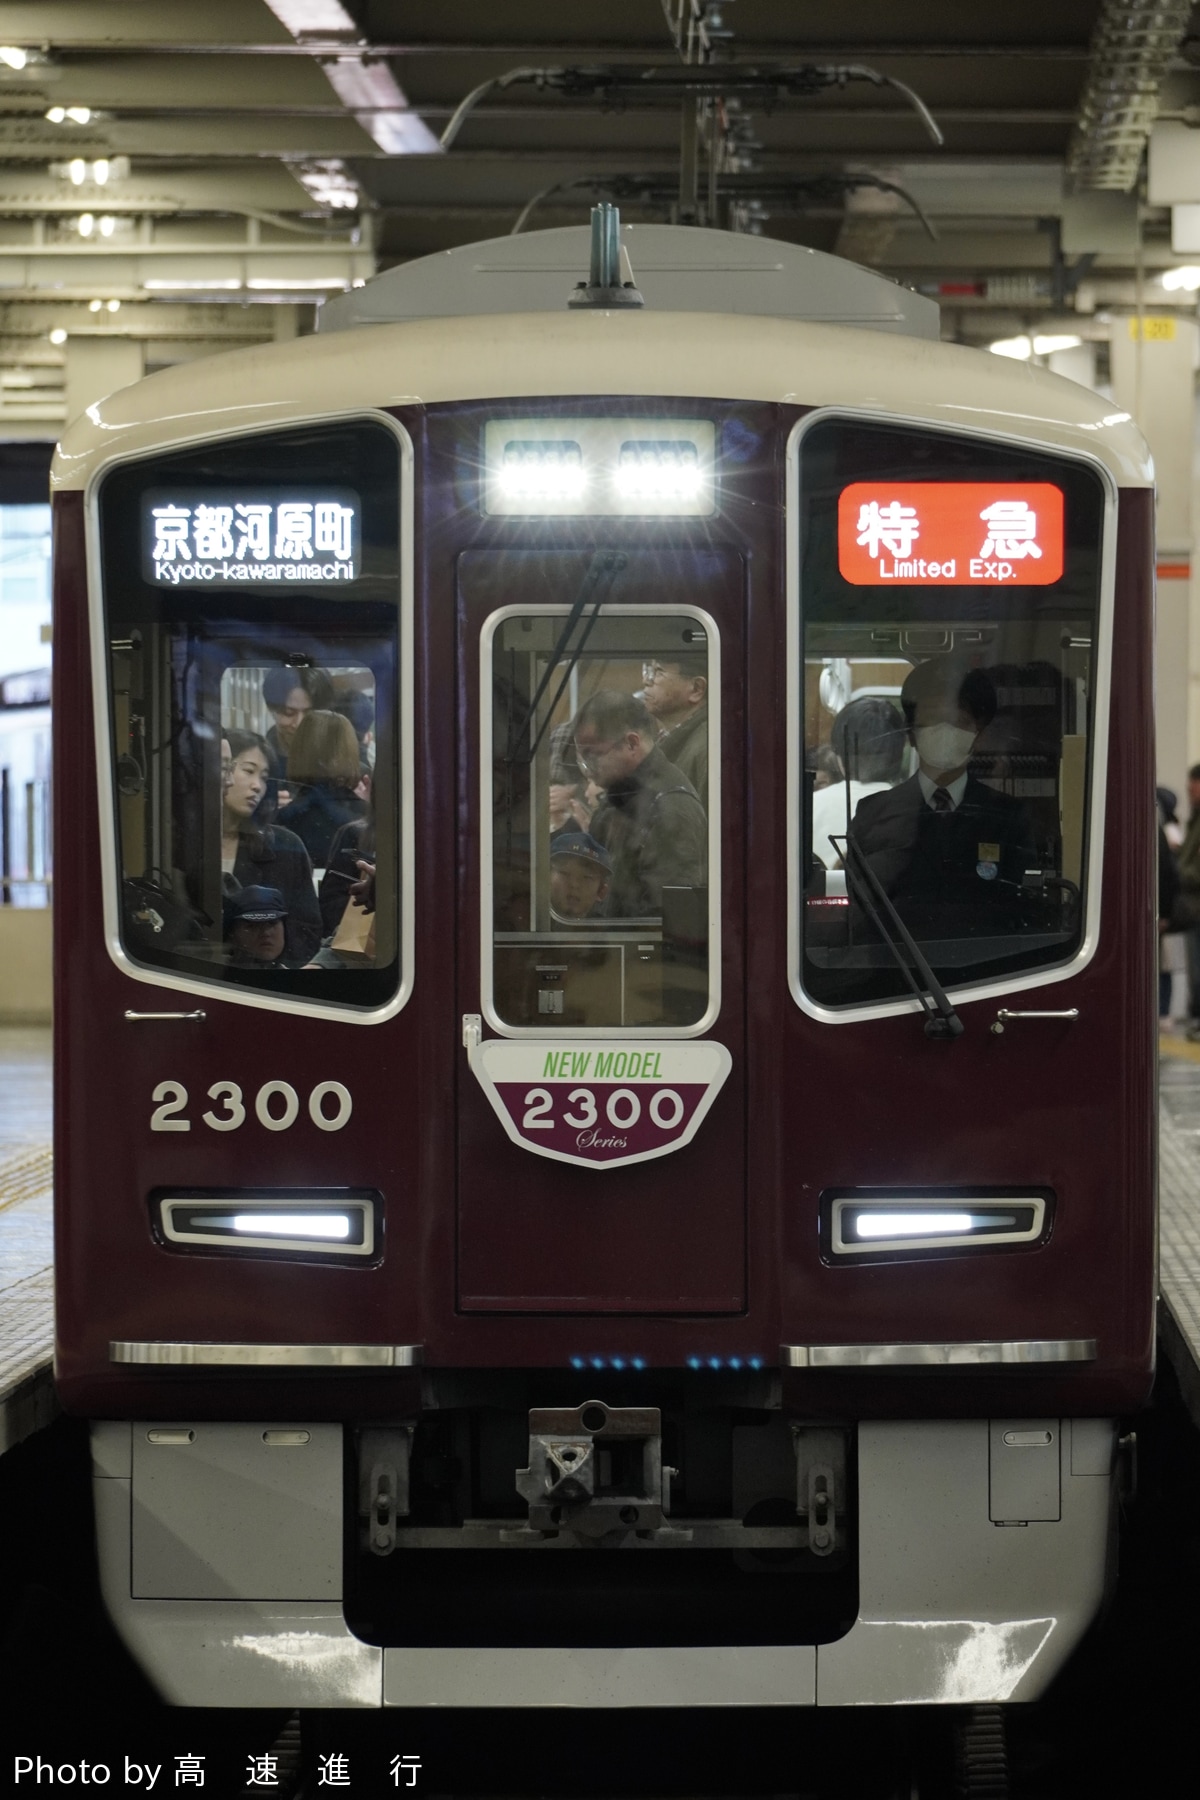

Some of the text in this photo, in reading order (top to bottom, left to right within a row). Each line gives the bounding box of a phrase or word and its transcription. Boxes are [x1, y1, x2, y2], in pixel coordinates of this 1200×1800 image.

[152, 503, 354, 561] 京都河原町
[155, 561, 354, 584] Kyoto-kawaramachi
[880, 559, 1018, 581] Limited Exp.
[543, 1052, 663, 1079] NEW MODEL
[151, 1080, 353, 1131] 2300
[522, 1088, 685, 1129] 2300
[576, 1128, 628, 1151] Series
